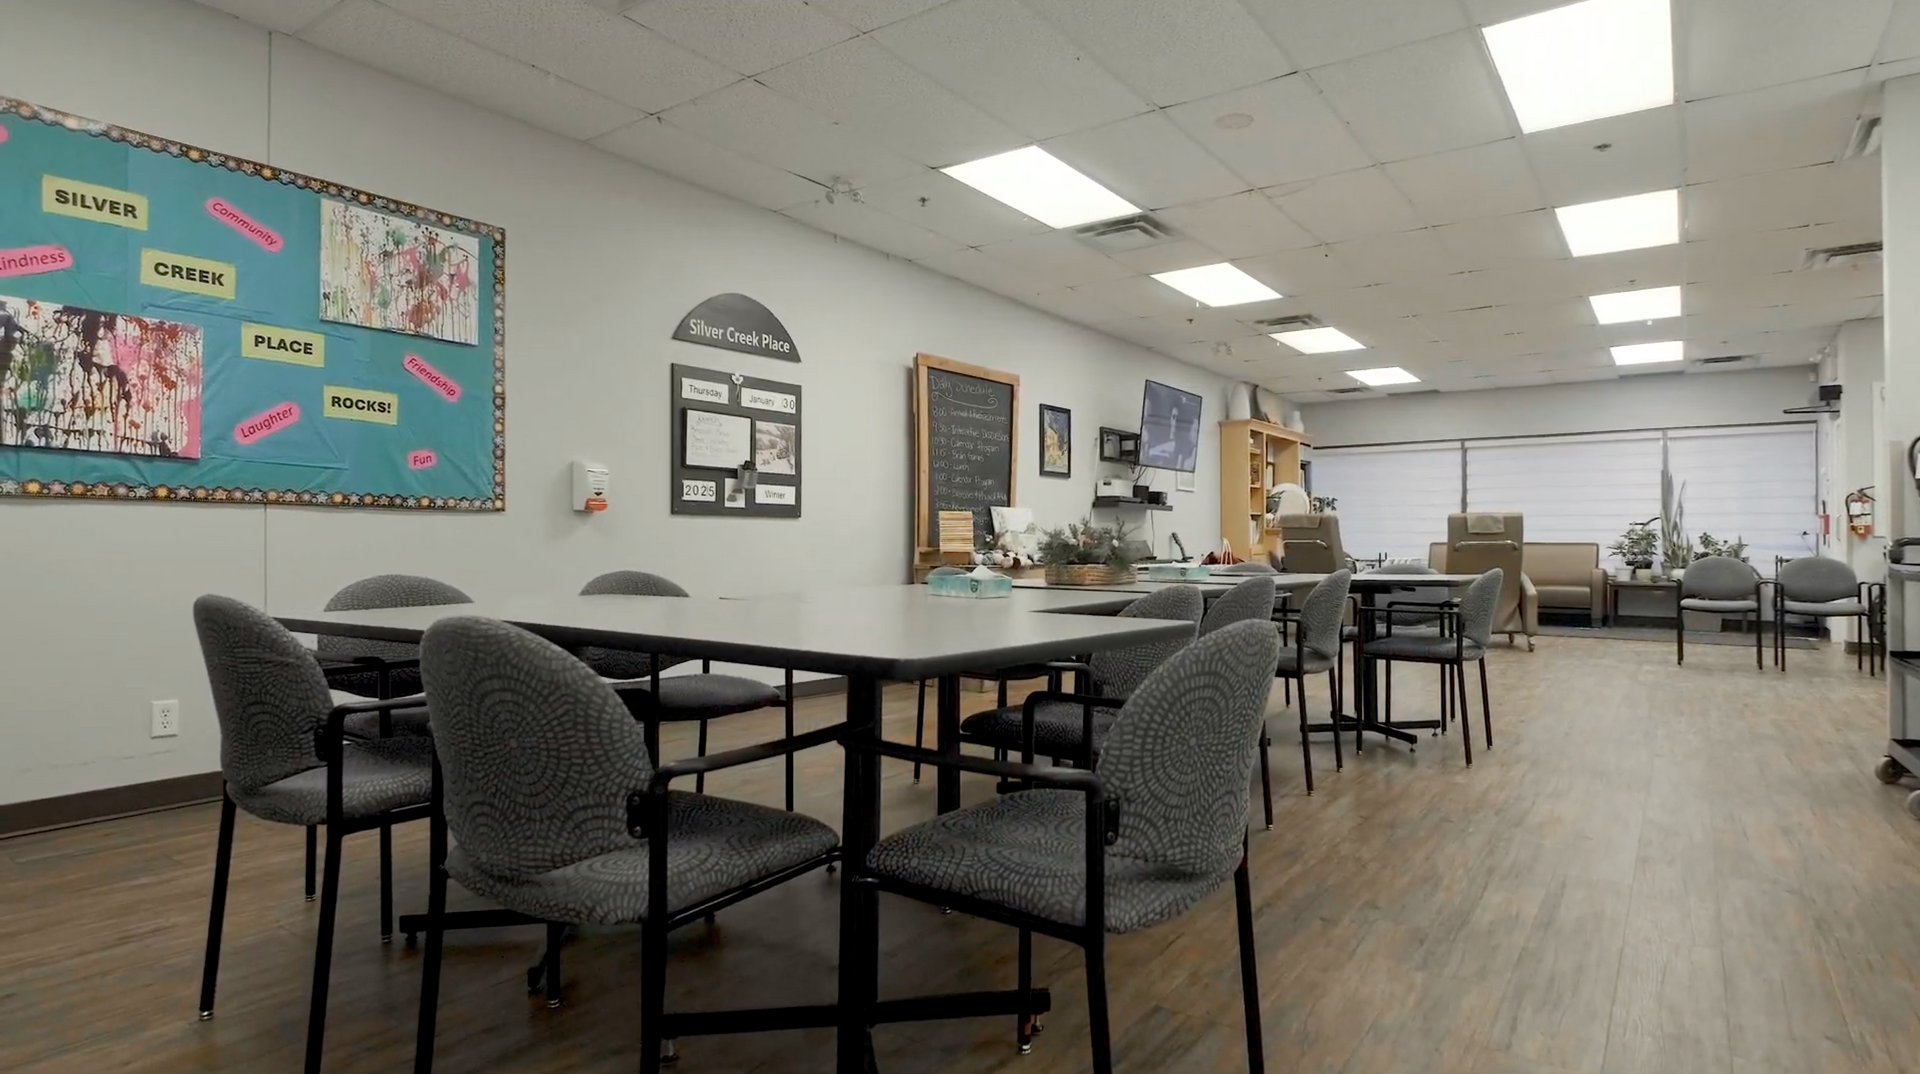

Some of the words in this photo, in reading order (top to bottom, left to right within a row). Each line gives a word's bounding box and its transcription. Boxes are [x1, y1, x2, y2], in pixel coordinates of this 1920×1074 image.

[55, 188, 138, 219] SILVER
[211, 201, 278, 249] Community
[153, 262, 225, 287] CREEK
[254, 334, 313, 356] PLACE
[689, 319, 724, 340] Silver
[727, 327, 759, 347] Creek
[762, 334, 790, 353] Place
[406, 357, 458, 397] Friendship
[688, 384, 723, 399] Thursday
[749, 395, 775, 408] January
[331, 395, 392, 415] ROCKS!
[783, 398, 795, 411] 30
[240, 404, 294, 439] Laughter
[412, 452, 433, 466] Fun
[685, 483, 715, 498] 2025
[764, 489, 786, 500] Winter
